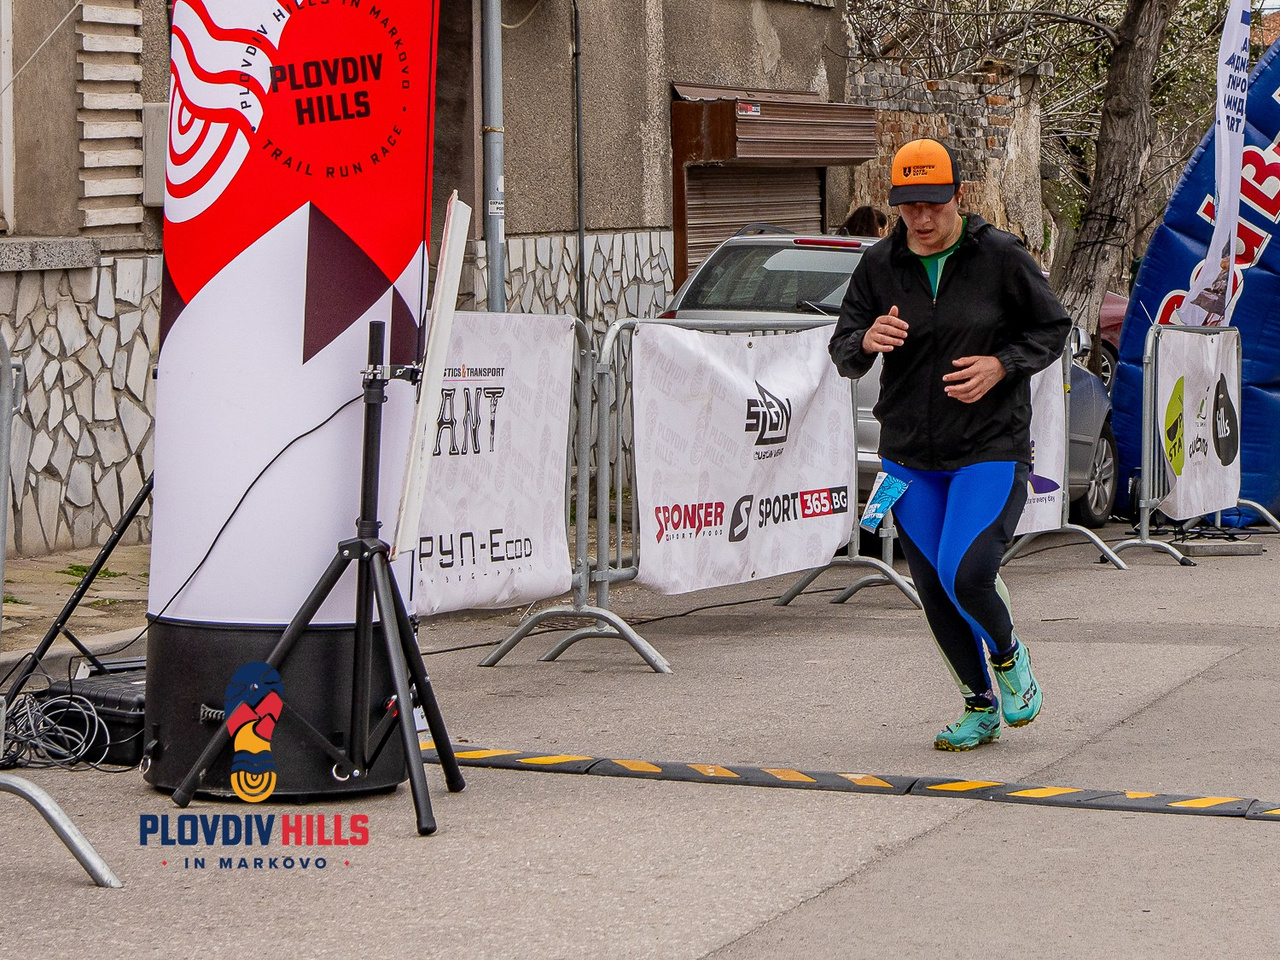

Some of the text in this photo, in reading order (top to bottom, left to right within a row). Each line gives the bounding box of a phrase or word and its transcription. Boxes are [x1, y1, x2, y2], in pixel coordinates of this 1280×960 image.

[240, 24, 268, 109] PLOVDIV
[369, 5, 410, 89] MARKOVO
[269, 53, 383, 94] PLOVDIV
[295, 91, 371, 126] HILLS
[262, 124, 402, 178] TRAIL RUN RACE
[655, 502, 724, 544] SPONSER
